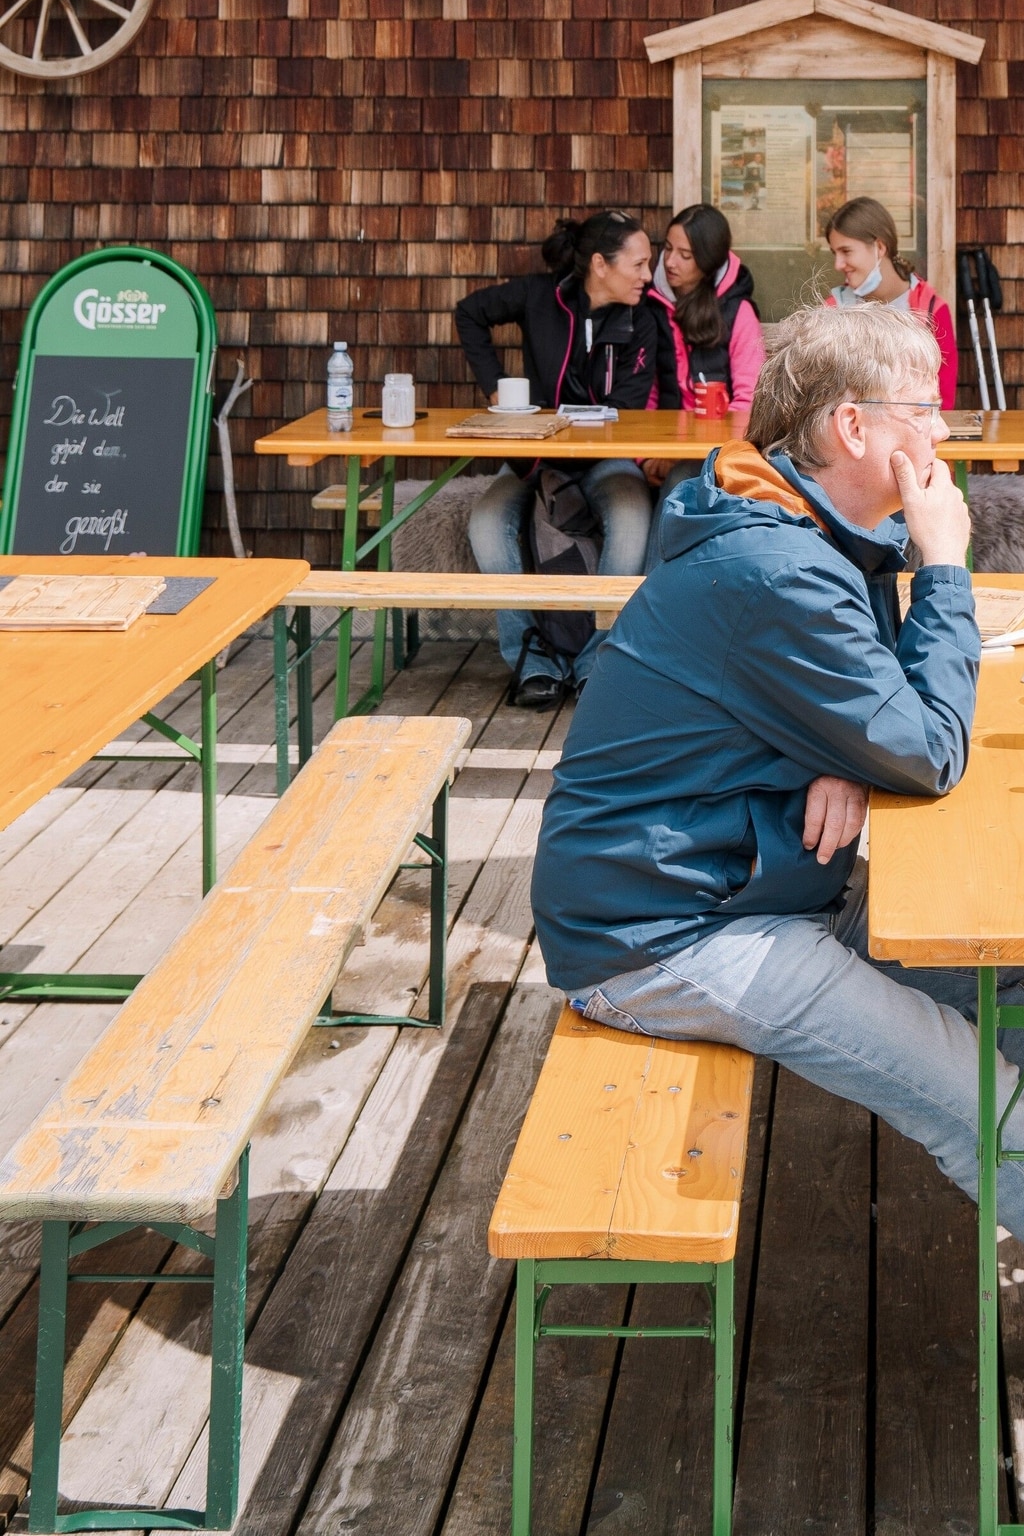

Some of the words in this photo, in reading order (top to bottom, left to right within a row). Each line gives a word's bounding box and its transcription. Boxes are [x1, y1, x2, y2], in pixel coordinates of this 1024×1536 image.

[73, 288, 167, 330] Gösser
[43, 395, 85, 426] Die
[87, 390, 125, 427] Welt
[50, 436, 87, 465] gehört
[44, 474, 69, 493] der
[81, 479, 102, 494] sie
